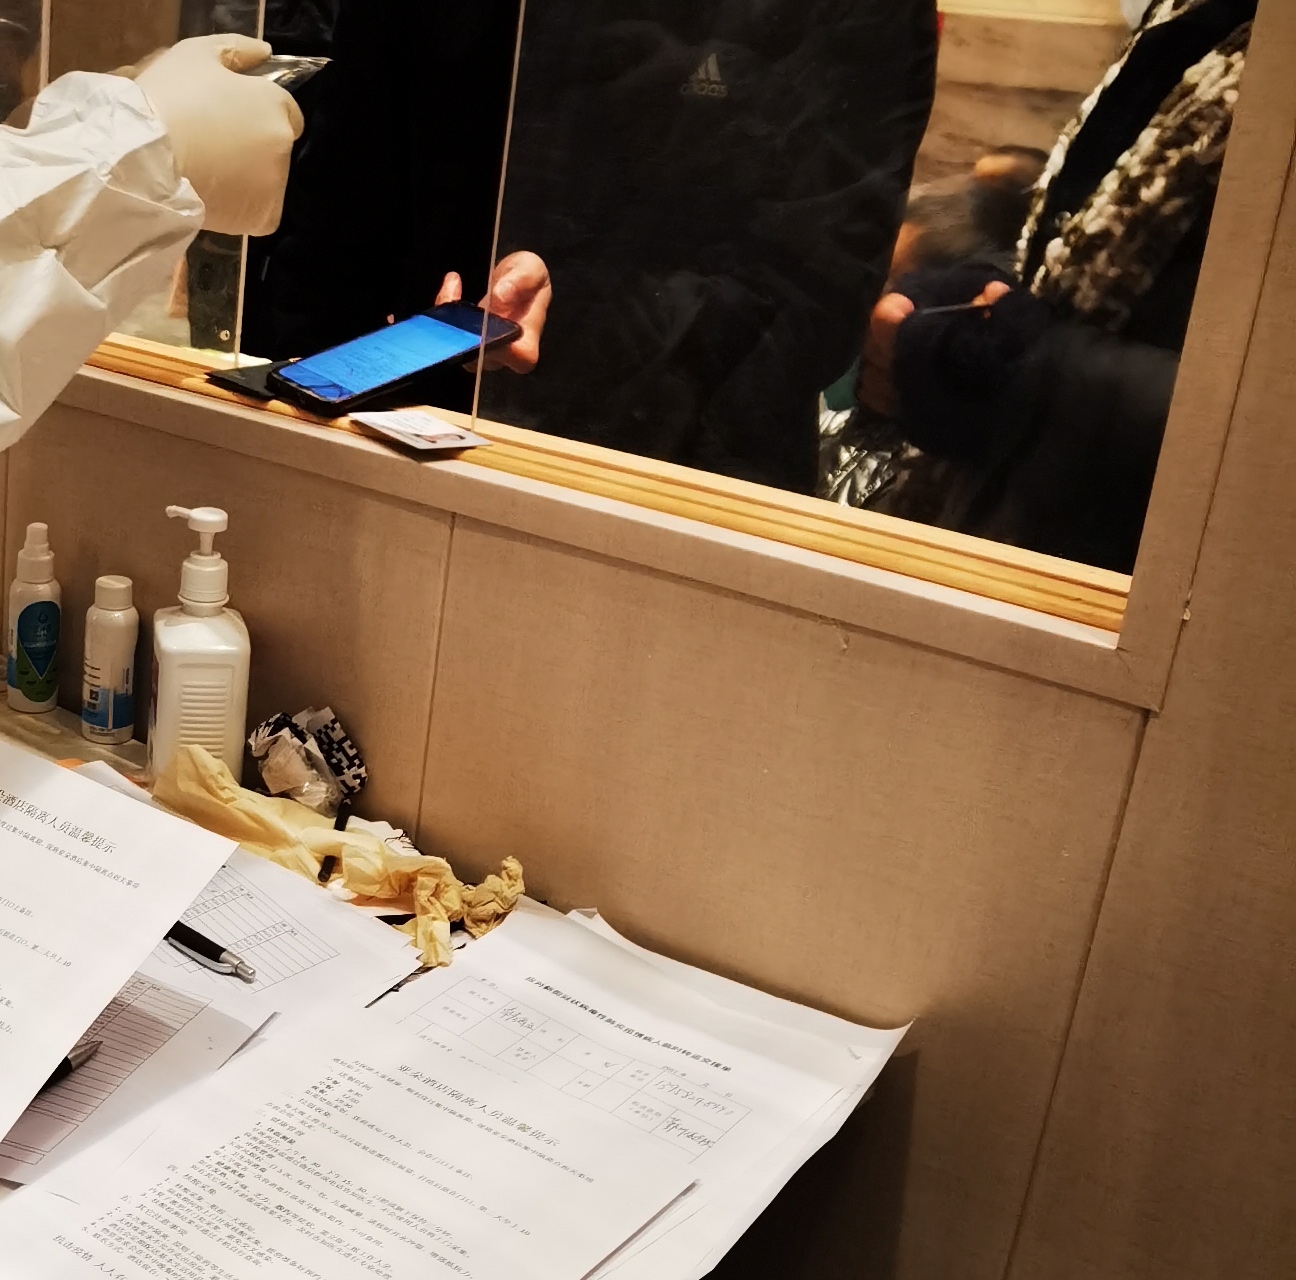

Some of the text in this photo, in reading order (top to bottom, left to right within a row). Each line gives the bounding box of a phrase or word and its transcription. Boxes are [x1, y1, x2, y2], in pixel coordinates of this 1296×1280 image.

[393, 1063, 564, 1149] 亚朵酒店隔离人员温馨提示
